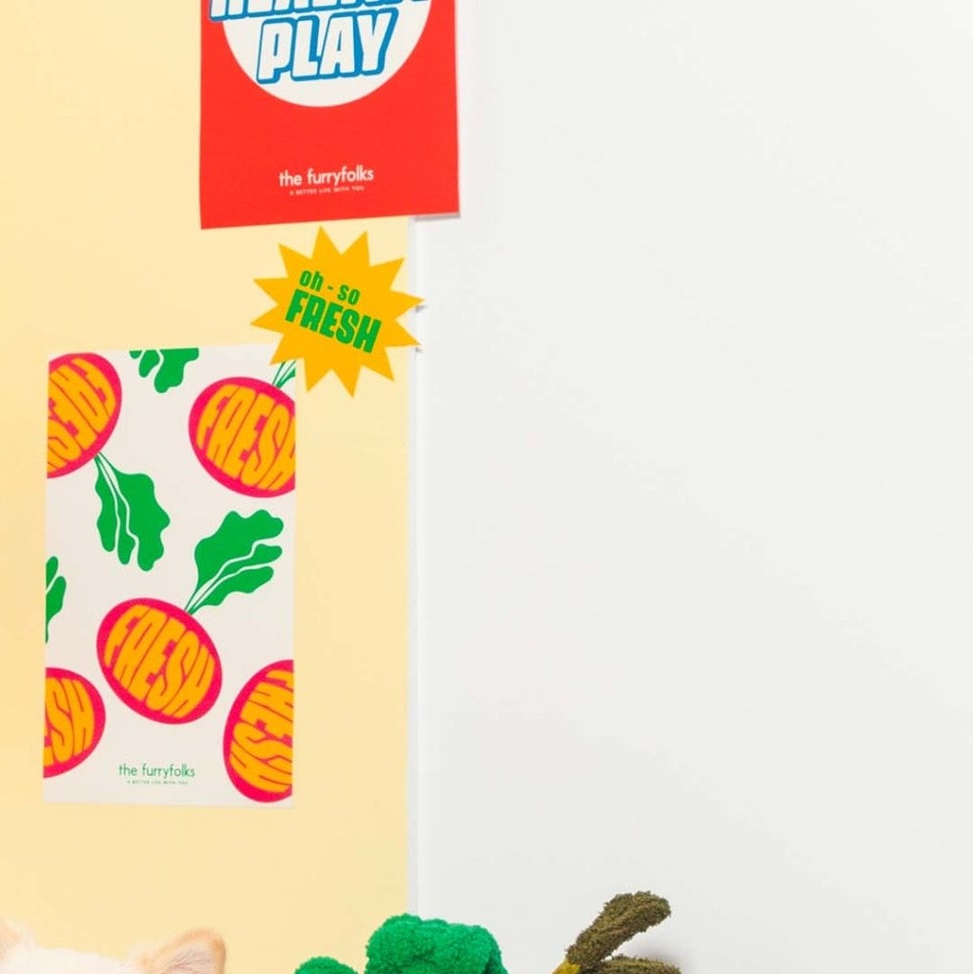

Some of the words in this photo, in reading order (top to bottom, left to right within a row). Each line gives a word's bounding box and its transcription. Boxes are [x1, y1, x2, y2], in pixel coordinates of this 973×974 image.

[257, 7, 399, 84] PLAY
[279, 169, 303, 187] the
[307, 164, 374, 187] furryfolks
[299, 270, 324, 292] oh
[337, 284, 361, 306] so
[285, 288, 382, 354] FRESH
[104, 603, 216, 719] FRESH
[119, 762, 138, 777] the
[142, 762, 196, 779] furryfolks
